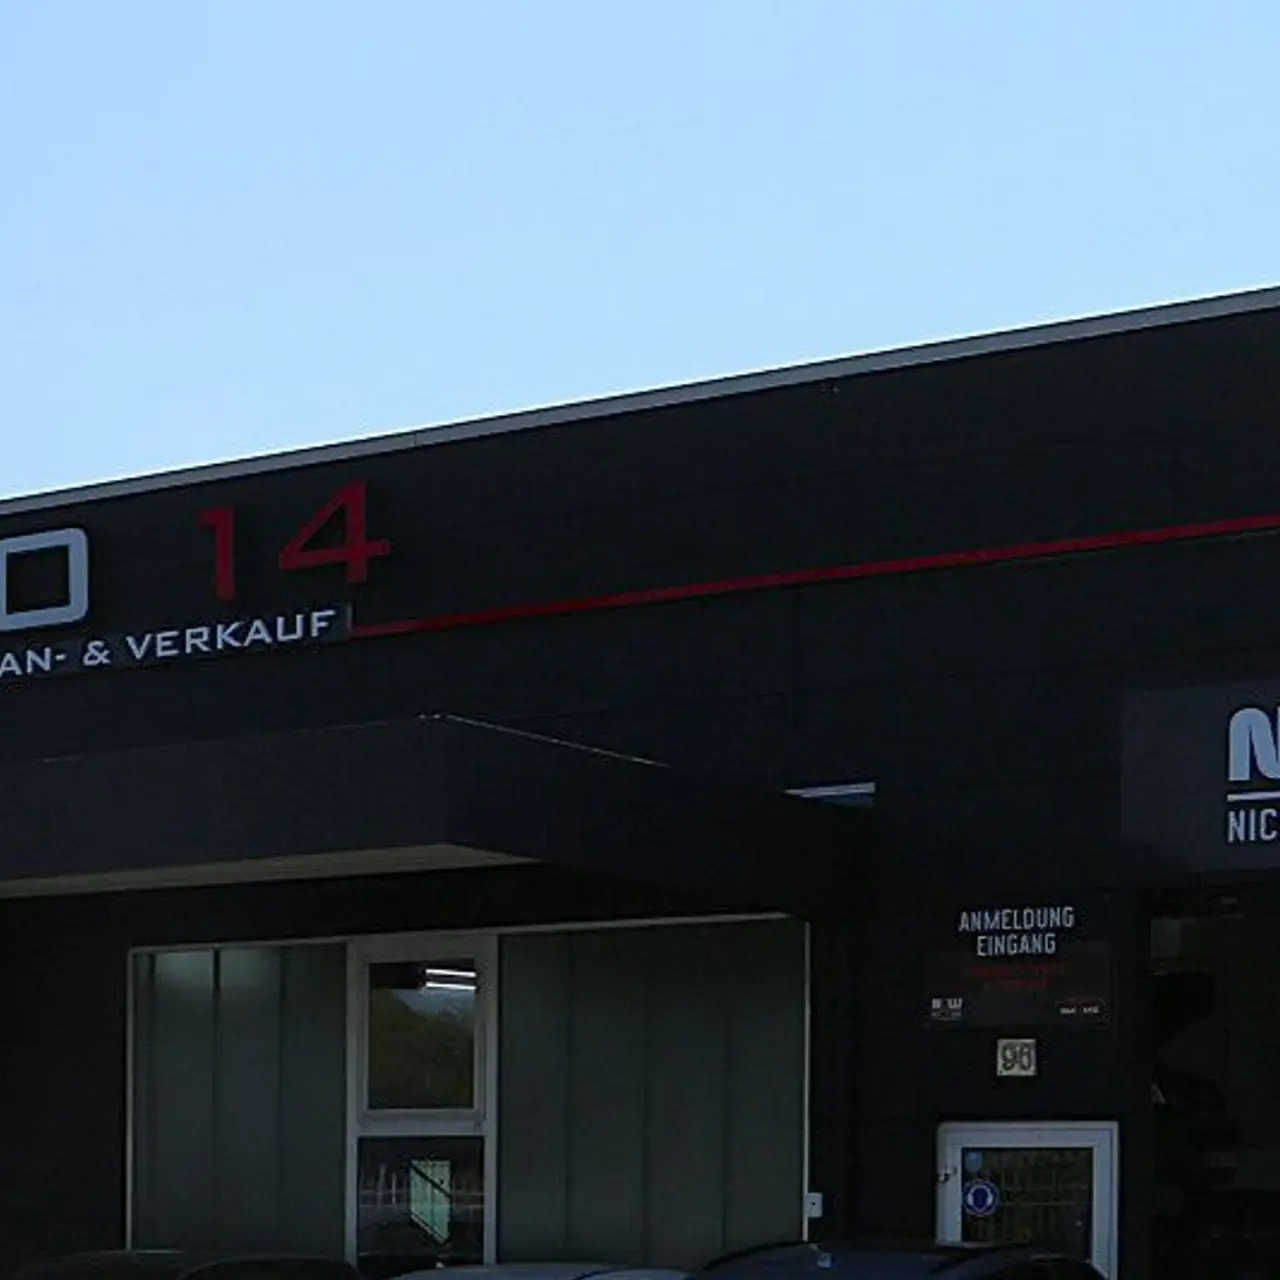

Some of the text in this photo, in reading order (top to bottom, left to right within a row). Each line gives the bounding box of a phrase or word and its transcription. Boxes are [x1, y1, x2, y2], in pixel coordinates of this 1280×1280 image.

[82, 640, 111, 666] &
[129, 608, 336, 660] VERKAUF
[958, 905, 1075, 932] ANMELDUNG
[976, 932, 1057, 957] EINGANG
